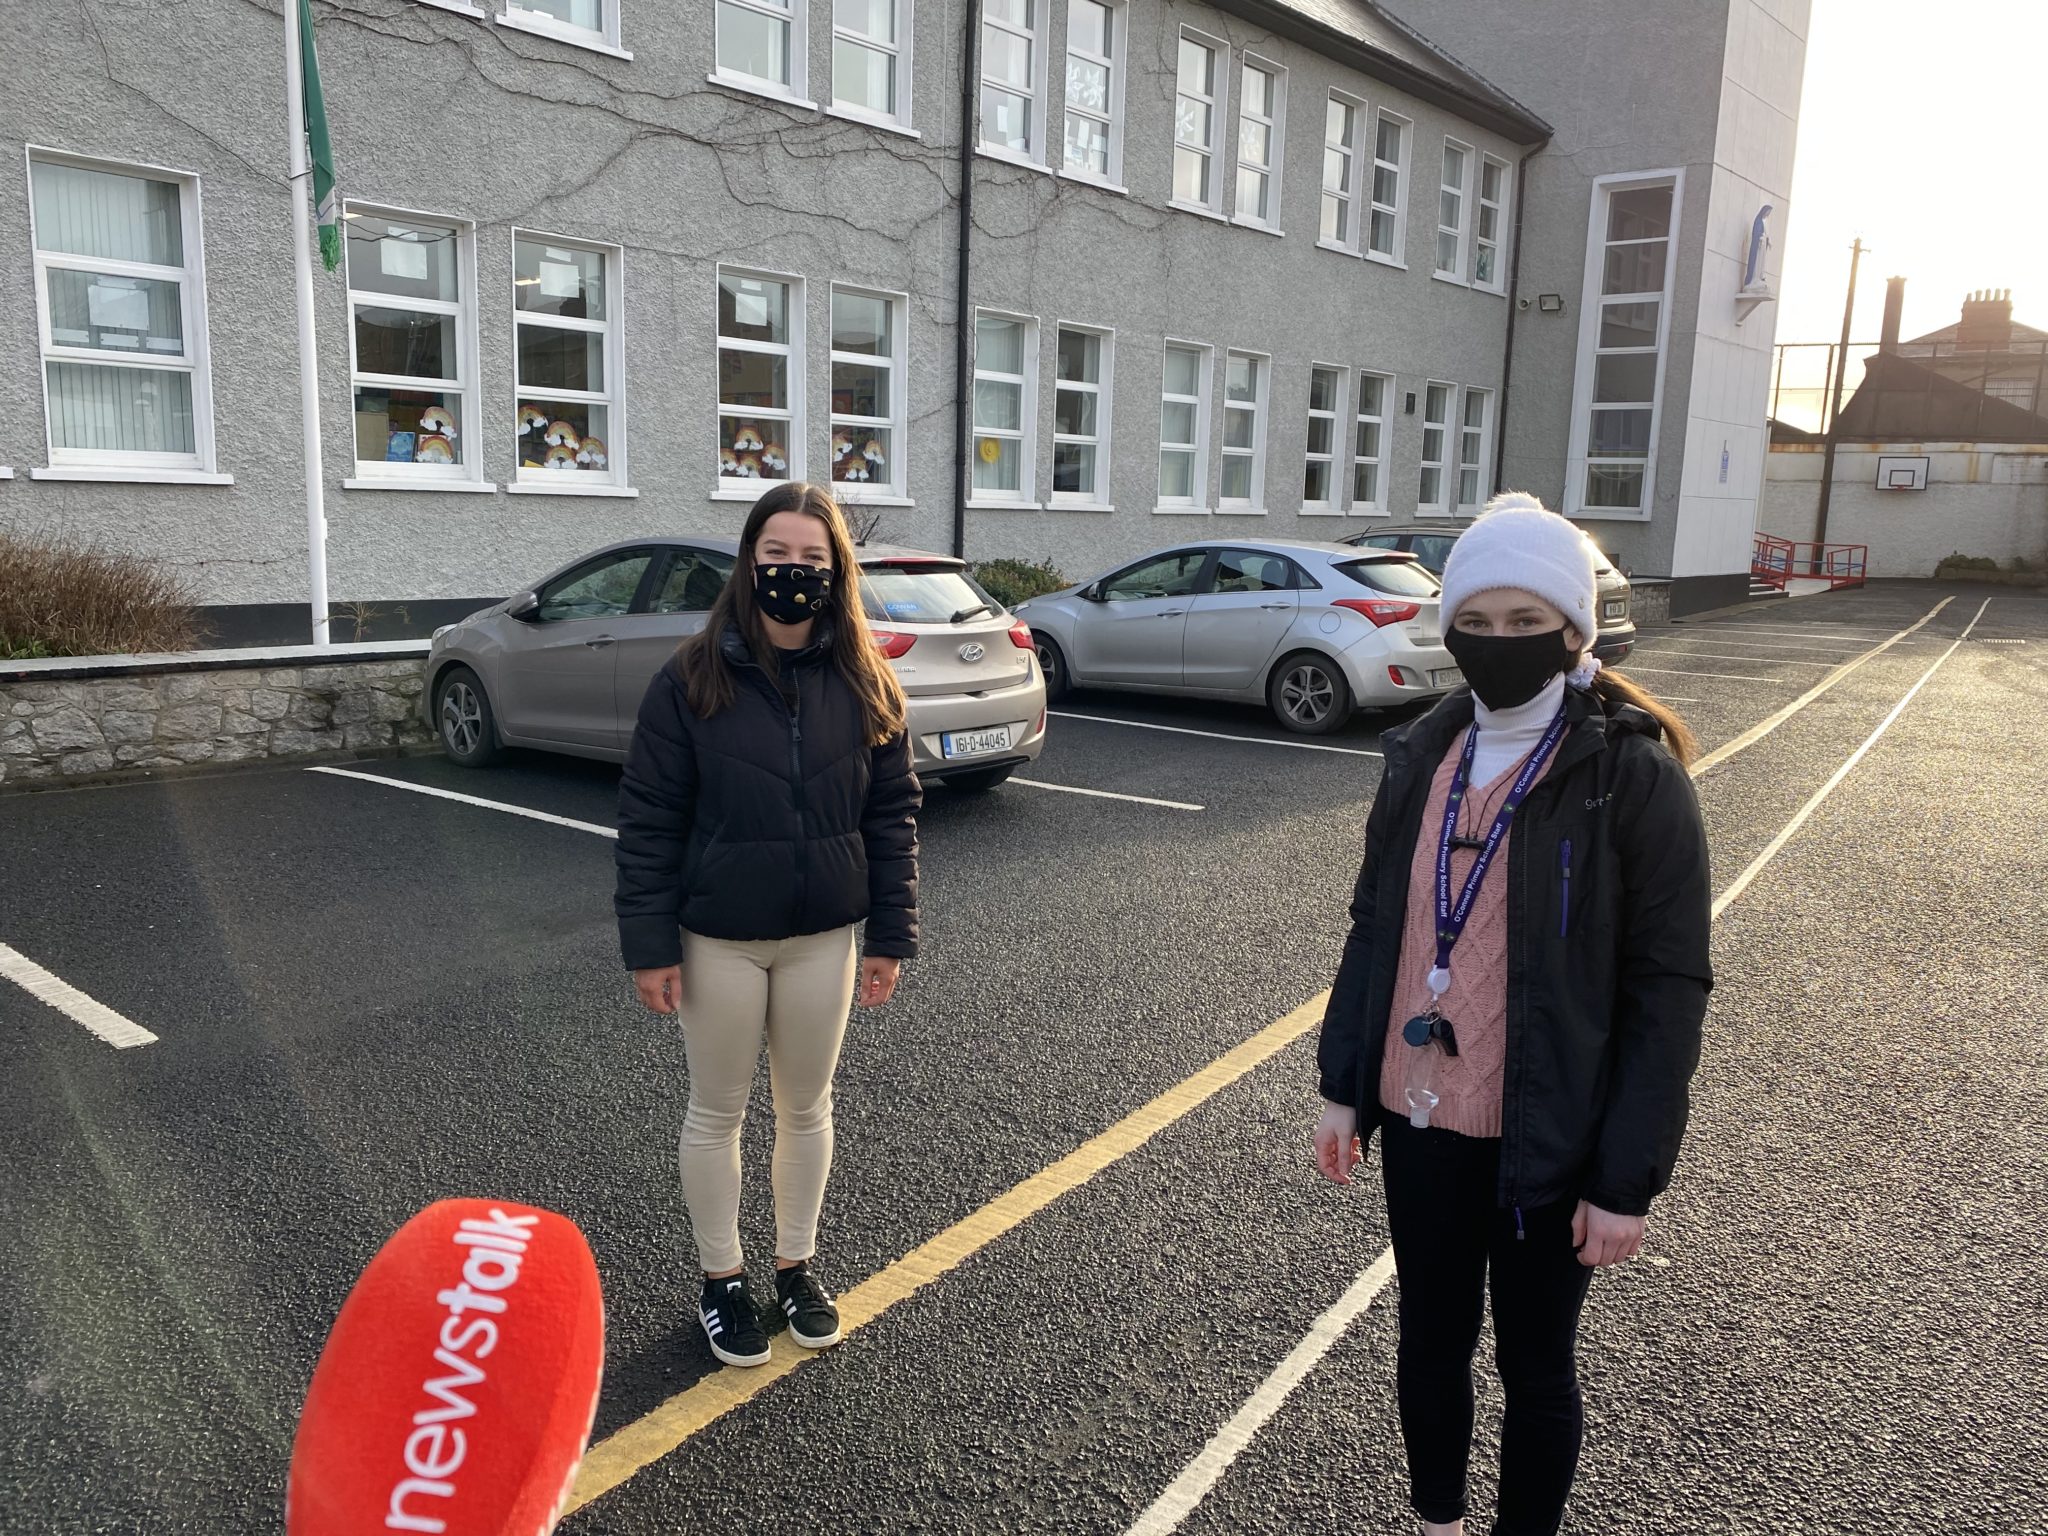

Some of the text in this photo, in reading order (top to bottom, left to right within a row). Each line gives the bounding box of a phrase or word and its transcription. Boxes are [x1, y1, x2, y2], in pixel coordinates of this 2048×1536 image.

[955, 732, 1006, 753] 161-D-44045
[1514, 762, 1537, 793] O'Connell
[1532, 738, 1553, 763] Primary
[1439, 811, 1456, 918] O'Connell Primary School Staff
[1453, 822, 1504, 923] O'Connell Primary School Staff
[384, 1208, 541, 1534] newstalk
